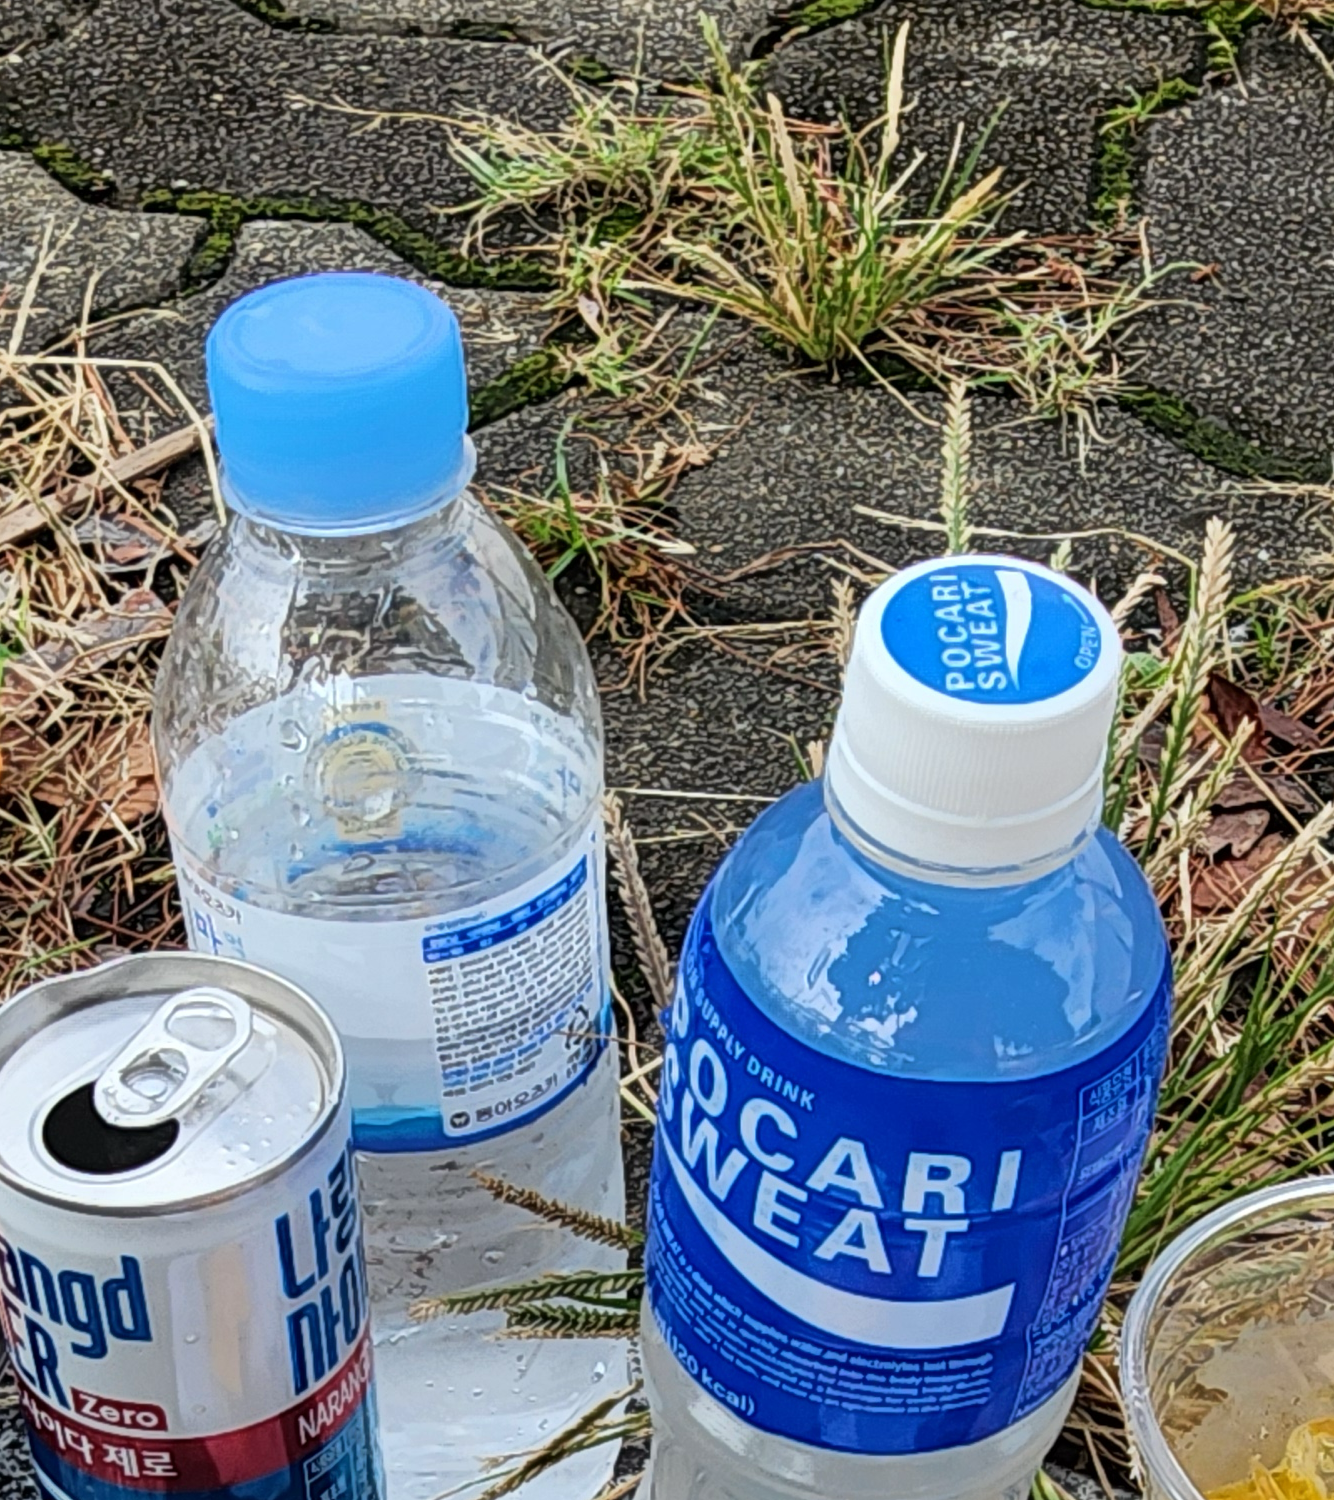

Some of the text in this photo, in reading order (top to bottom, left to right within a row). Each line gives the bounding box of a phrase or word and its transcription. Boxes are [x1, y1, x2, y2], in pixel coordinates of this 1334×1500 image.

[930, 573, 975, 692] POCARI
[961, 580, 1008, 691] SWEAT
[1074, 623, 1099, 671] OPEN
[670, 972, 1023, 1214] POCARI
[693, 986, 747, 1062] SUPPLY
[746, 1054, 816, 1113] DRINK
[661, 1042, 969, 1279] SWEAT
[79, 1393, 159, 1429] Zero
[699, 1366, 757, 1418] kcal)
[102, 1448, 178, 1478] 제로
